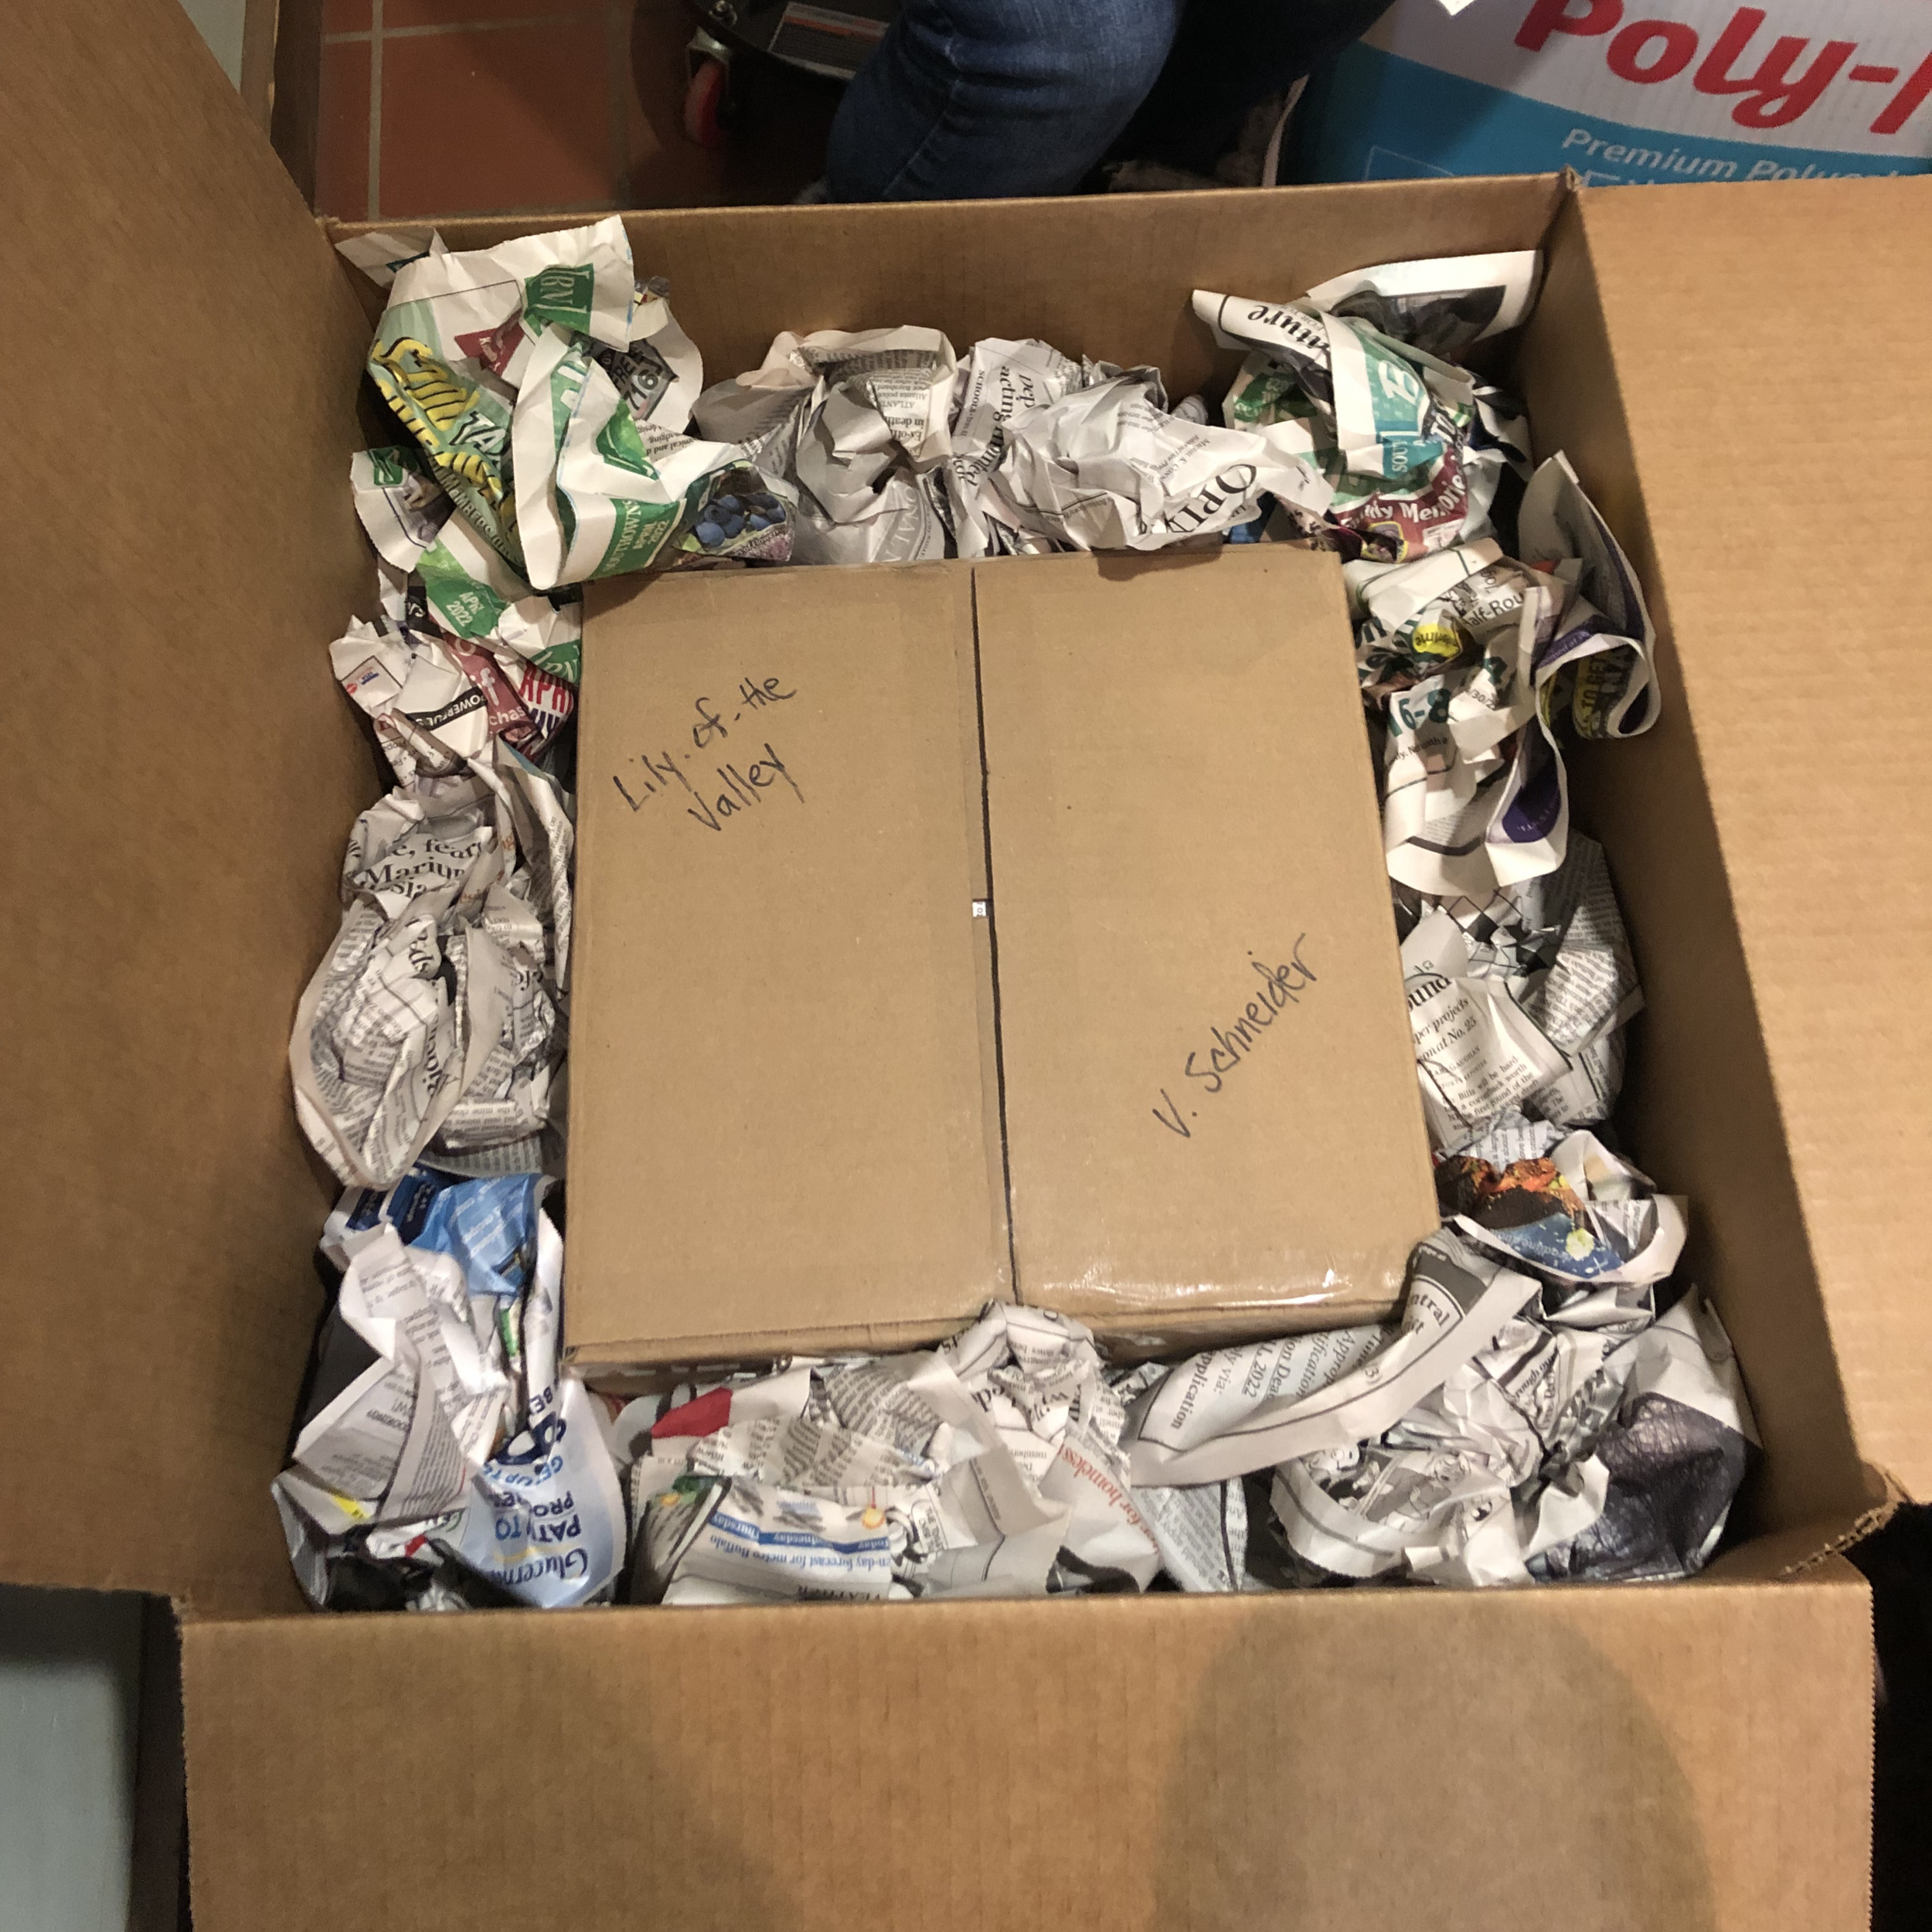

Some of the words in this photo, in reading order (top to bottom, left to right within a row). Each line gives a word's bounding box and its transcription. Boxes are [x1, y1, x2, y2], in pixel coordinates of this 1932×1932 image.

[1561, 128, 1739, 183] Premium
[914, 419, 925, 430] in
[445, 597, 474, 628] 2022
[687, 743, 805, 832] Valley
[1429, 997, 1473, 1032] projects
[1151, 1088, 1198, 1138] V.
[1185, 932, 1317, 1093] Schneider
[1433, 1036, 1449, 1052] at
[1446, 1025, 1467, 1044] No.
[1463, 1017, 1478, 1032] 25
[1488, 1069, 1500, 1080] be
[1503, 1063, 1528, 1082] worth
[1488, 1087, 1513, 1107] round
[1511, 1080, 1522, 1090] of
[1520, 1070, 1535, 1083] the
[1210, 1365, 1236, 1397] via:
[1239, 1359, 1270, 1400] 2022
[1061, 1444, 1124, 1509] homeless
[495, 1515, 522, 1541] TO
[710, 1535, 750, 1559] Buffalo
[753, 1552, 787, 1563] metro
[788, 1555, 807, 1568] for
[809, 1556, 853, 1572] forecast
